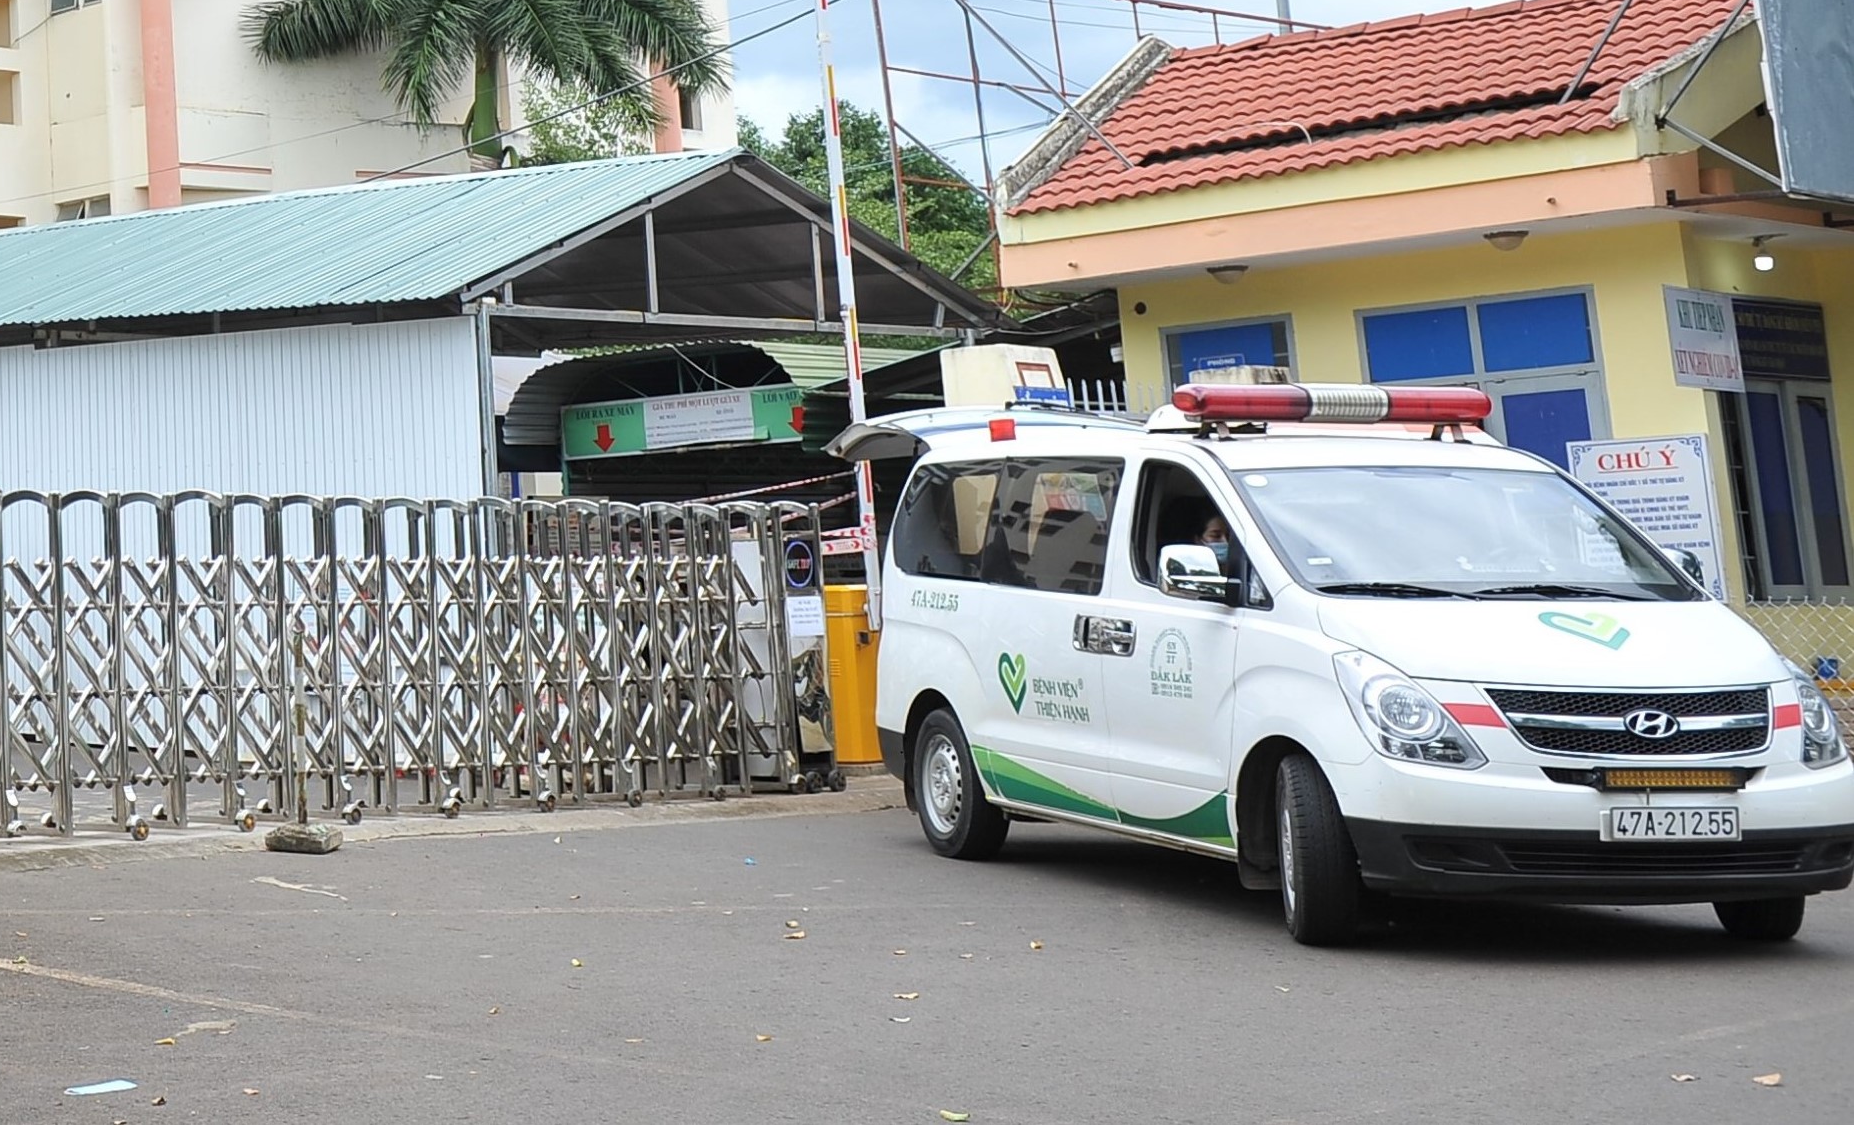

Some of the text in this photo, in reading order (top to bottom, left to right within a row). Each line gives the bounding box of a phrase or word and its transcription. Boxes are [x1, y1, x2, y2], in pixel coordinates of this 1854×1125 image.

[1598, 444, 1676, 471] CHÚ Ý
[911, 589, 959, 612] 47A-212.55
[1033, 677, 1056, 698] BỆNH
[1034, 700, 1090, 723] THIỆN HẠNH
[1617, 811, 1734, 836] 47A-212.55
